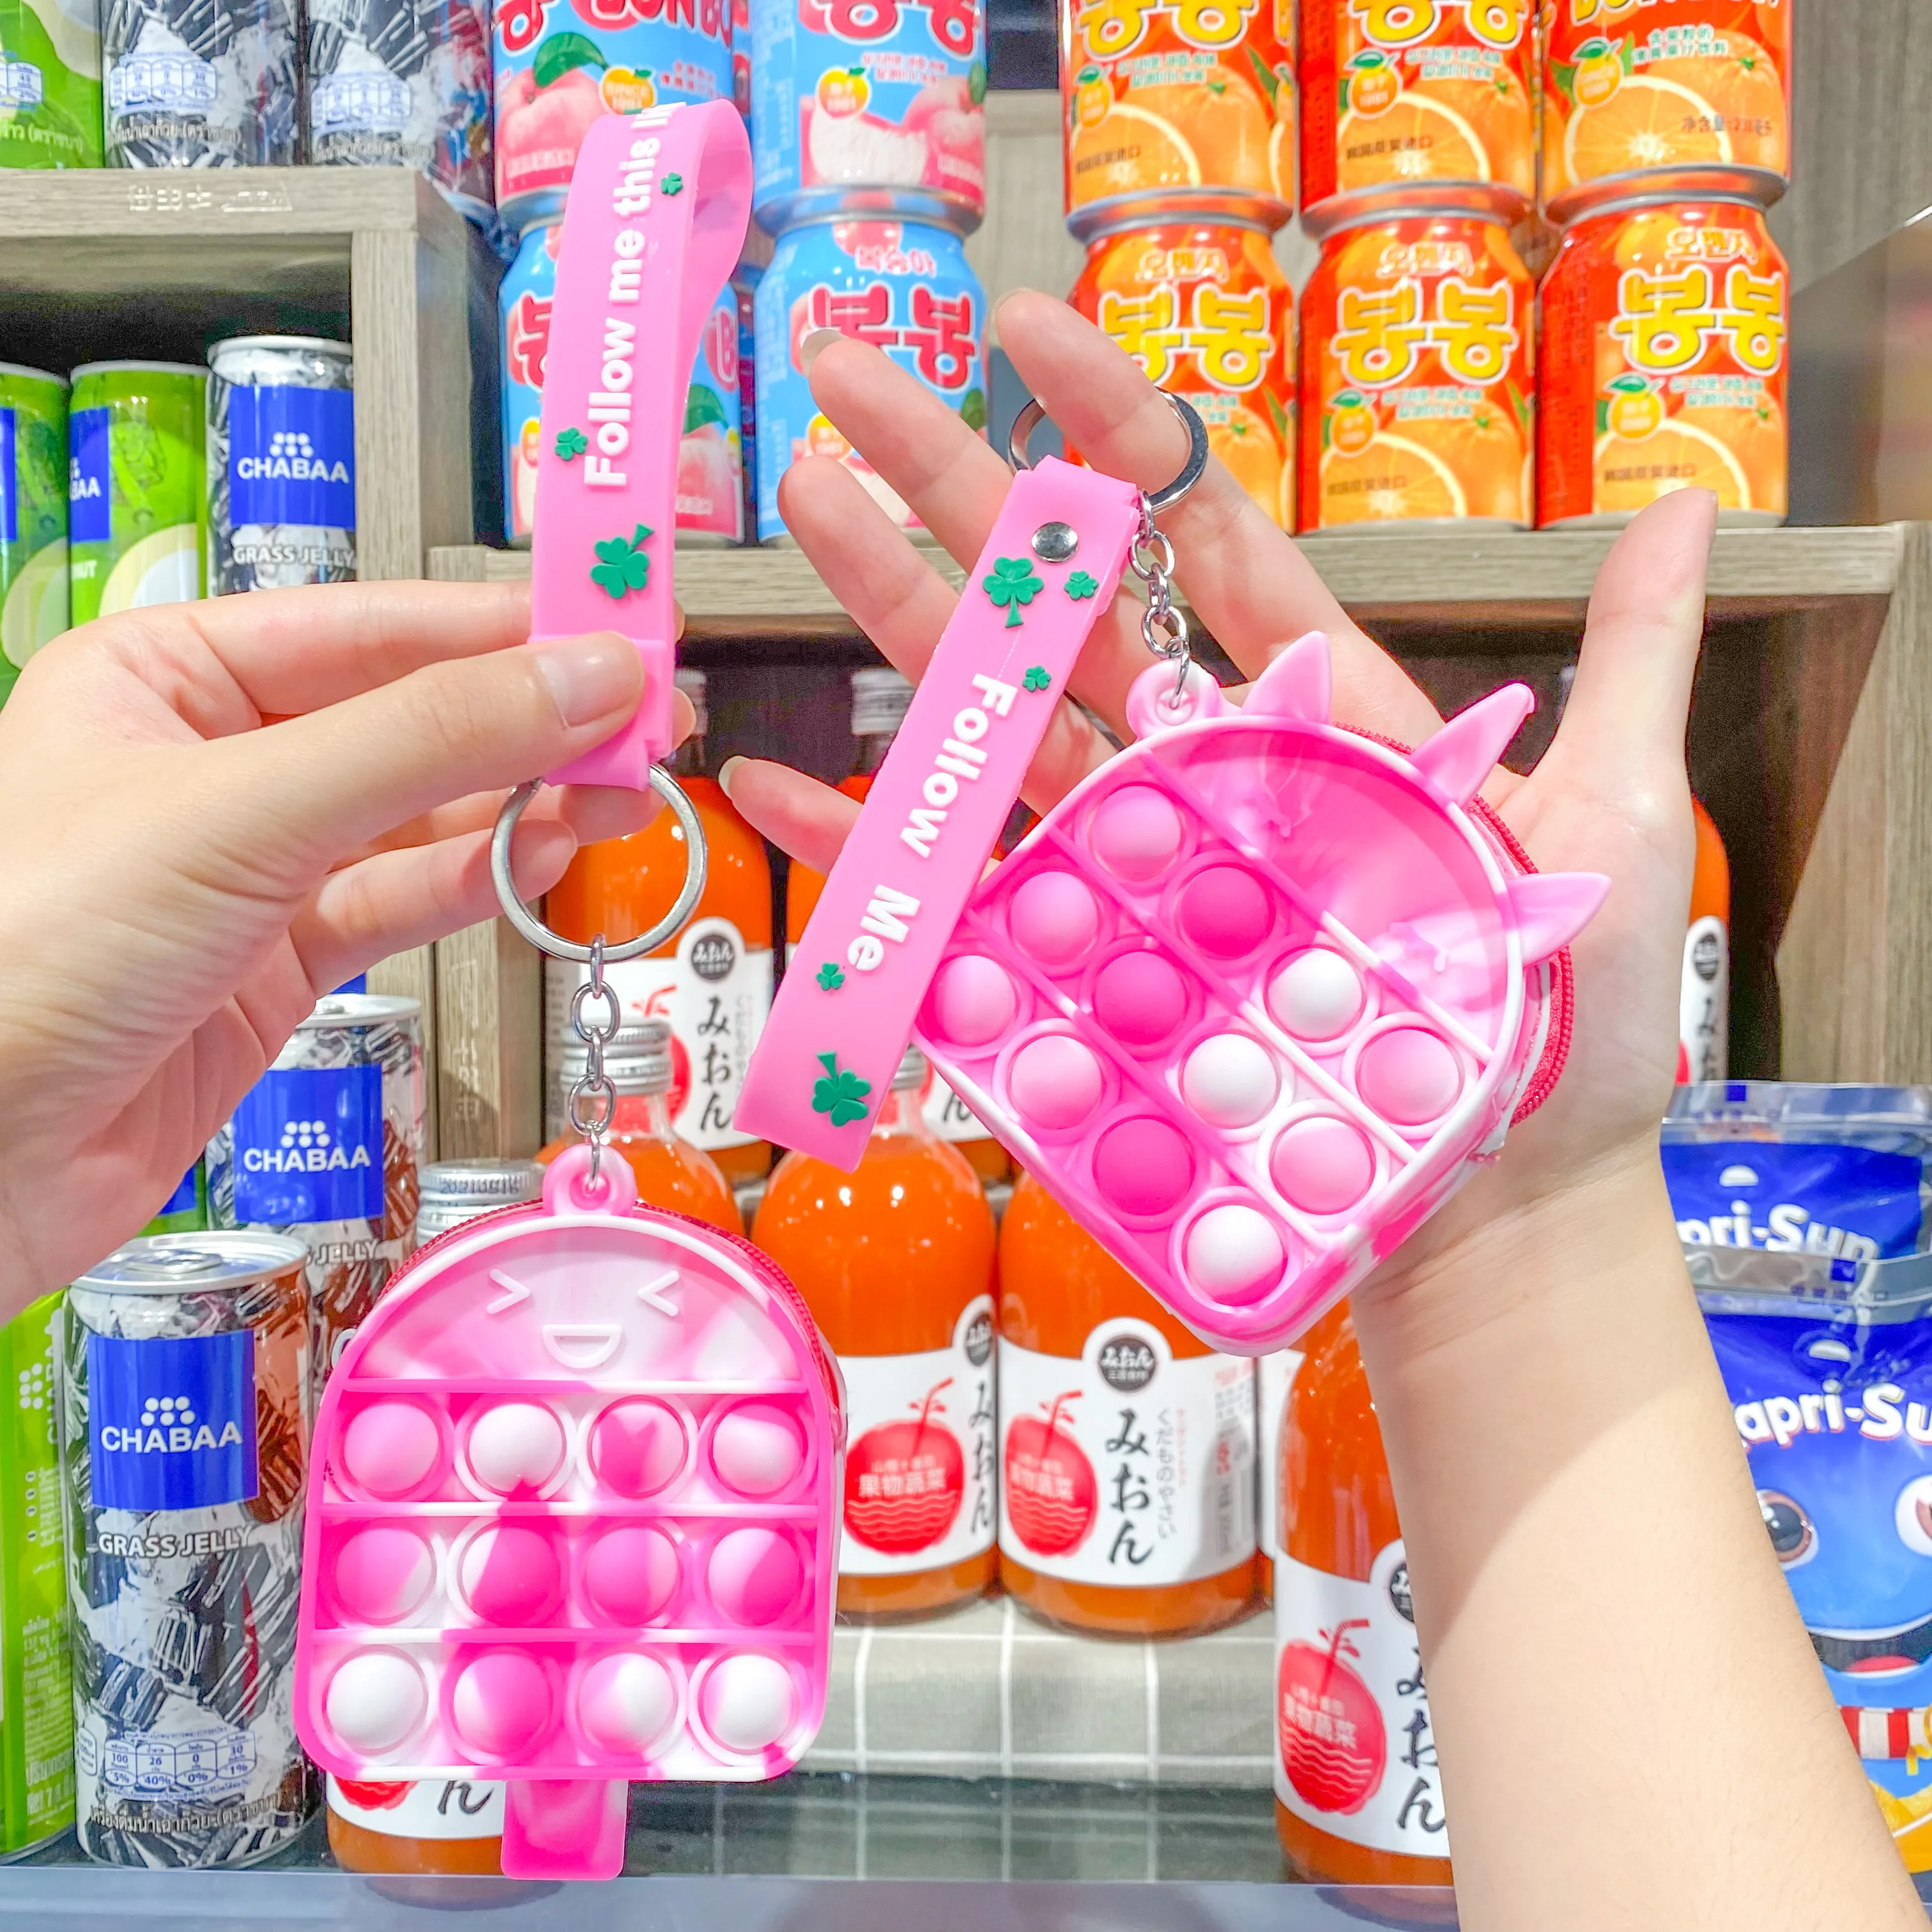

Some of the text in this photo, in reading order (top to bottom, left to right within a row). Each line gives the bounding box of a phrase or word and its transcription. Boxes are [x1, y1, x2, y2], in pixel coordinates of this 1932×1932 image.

[612, 137, 661, 217] this
[609, 229, 645, 303] me
[1332, 278, 1517, 388] 봉봉
[1609, 264, 1787, 376] 봉봉
[584, 317, 636, 486] Follow
[236, 457, 350, 484] CHABAA
[233, 544, 355, 569] GRASS JELLY
[847, 673, 1018, 971] Follow Me
[697, 993, 734, 1131] みおん
[243, 1145, 372, 1173] CHABAA
[315, 1238, 378, 1266] JELLY
[100, 1420, 243, 1454] CHABAA
[1105, 1407, 1154, 1565] みおん
[98, 1526, 254, 1558] GRASS JELLY
